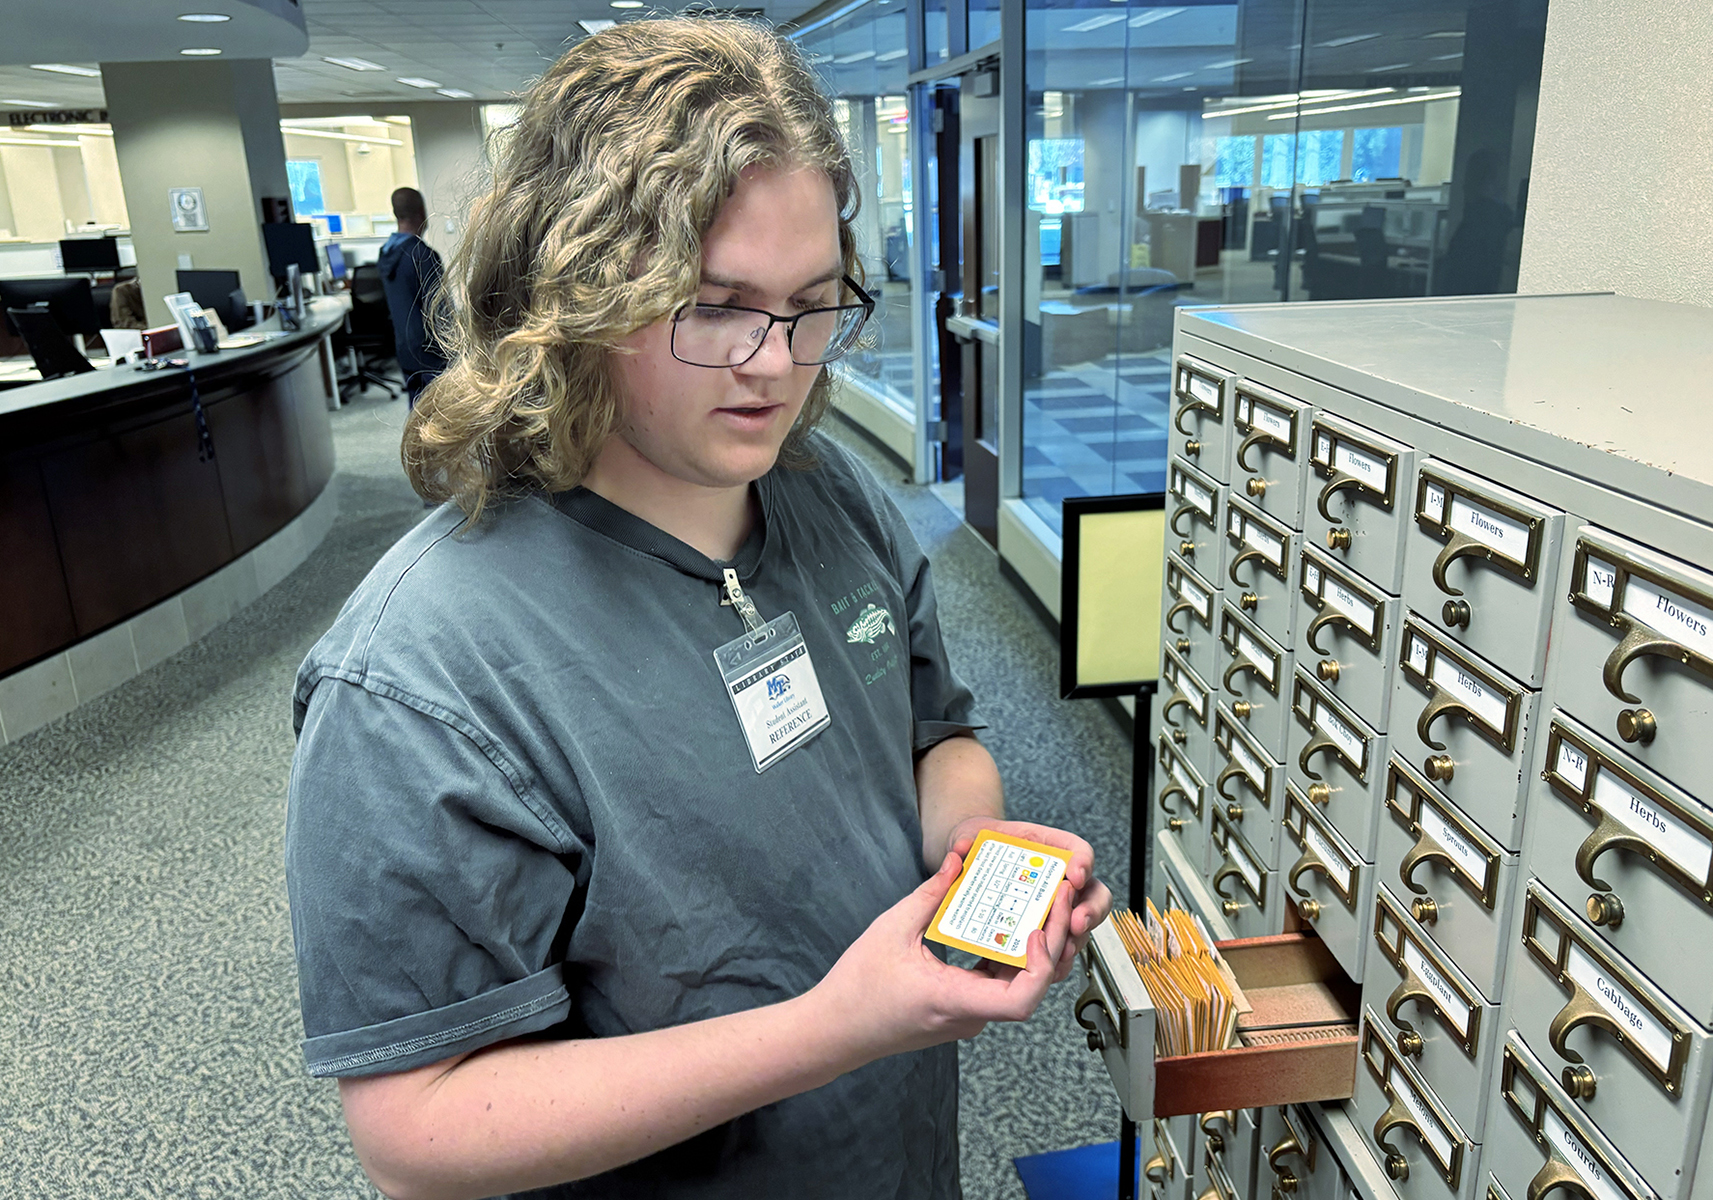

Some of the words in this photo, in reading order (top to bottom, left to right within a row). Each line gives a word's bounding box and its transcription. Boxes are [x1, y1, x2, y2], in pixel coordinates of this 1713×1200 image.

[9, 110, 92, 126] ELECTRONIC
[1263, 412, 1280, 428] Flowers
[1348, 452, 1371, 472] Flowers
[1470, 511, 1504, 538] Flowers
[831, 596, 850, 615] BAIT
[1337, 587, 1354, 607] Herbs
[1593, 570, 1615, 588] N-R
[1656, 594, 1707, 636] Flowers
[735, 666, 775, 691] LIBRARY
[1458, 672, 1482, 697] Herbs
[766, 711, 786, 729] Student
[787, 697, 808, 715] Assistant
[769, 708, 812, 744] REFERENCE
[1562, 747, 1584, 772] N-R
[1629, 795, 1667, 833] Herbs
[1442, 827, 1469, 857] Sprouts
[1034, 887, 1045, 901] Baba
[1010, 938, 1020, 952] 2025
[1421, 960, 1451, 1003] Eggplant
[1597, 977, 1643, 1030] Cabbage
[1410, 1090, 1433, 1128] Melons
[1564, 1131, 1601, 1180] Gourds
